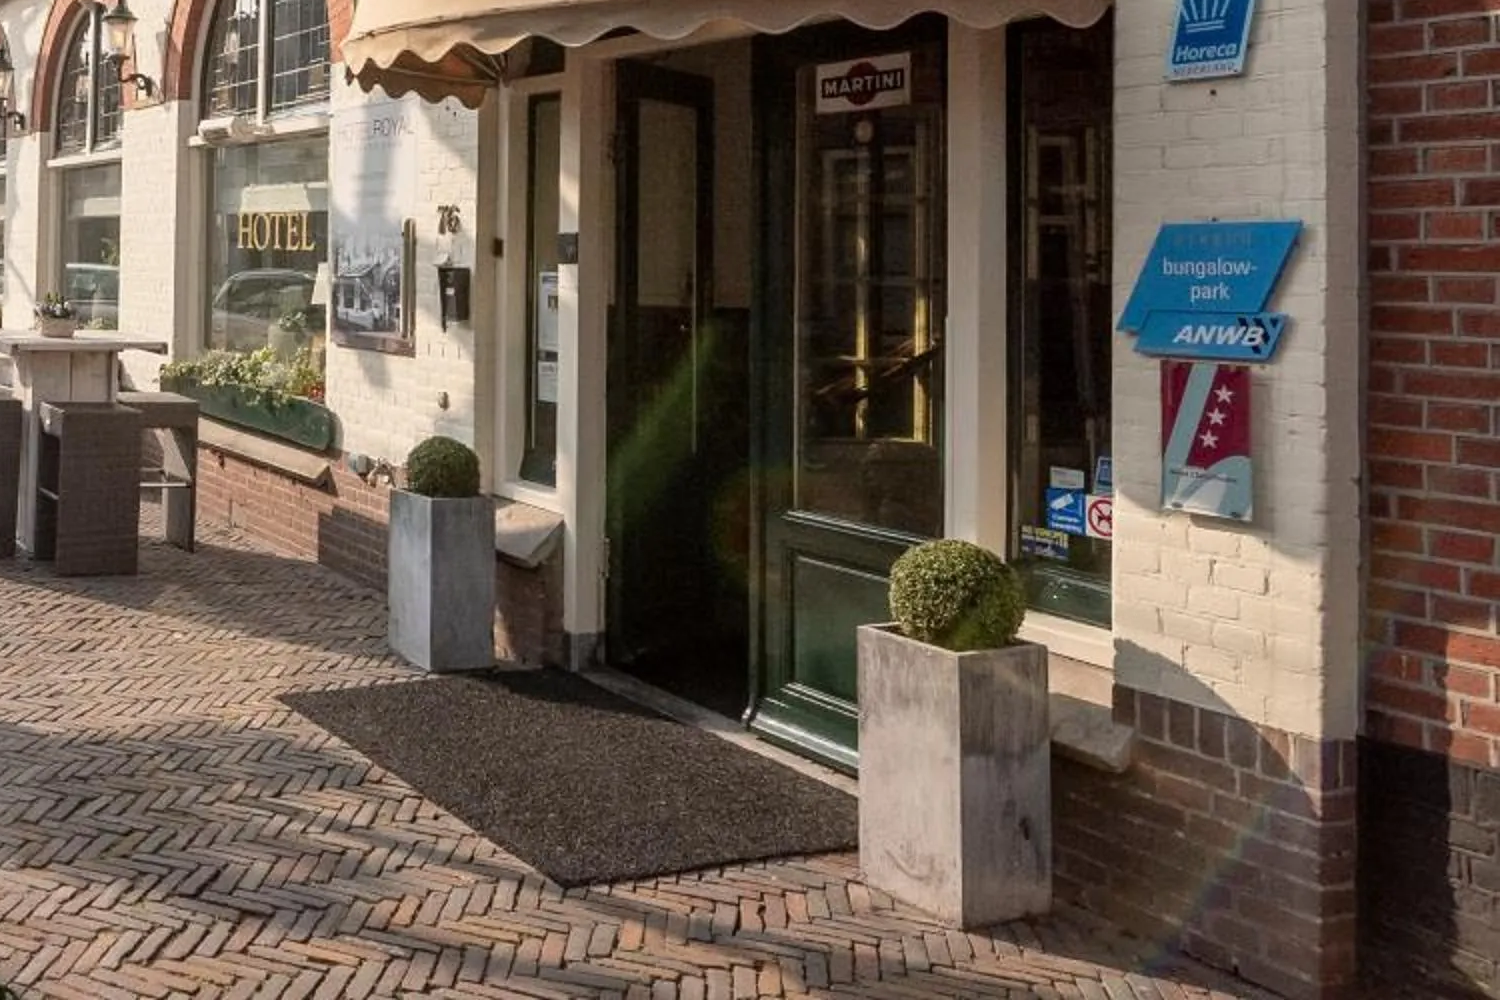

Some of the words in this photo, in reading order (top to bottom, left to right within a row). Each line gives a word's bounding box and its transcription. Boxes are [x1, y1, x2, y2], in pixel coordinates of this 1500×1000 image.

[1175, 42, 1237, 62] Horeca
[823, 71, 901, 97] MARTINI
[236, 211, 316, 251] HOTEL
[437, 204, 461, 235] 76
[1163, 256, 1258, 279] bungalow-
[1190, 281, 1230, 303] park
[1171, 324, 1265, 346] ANWB
